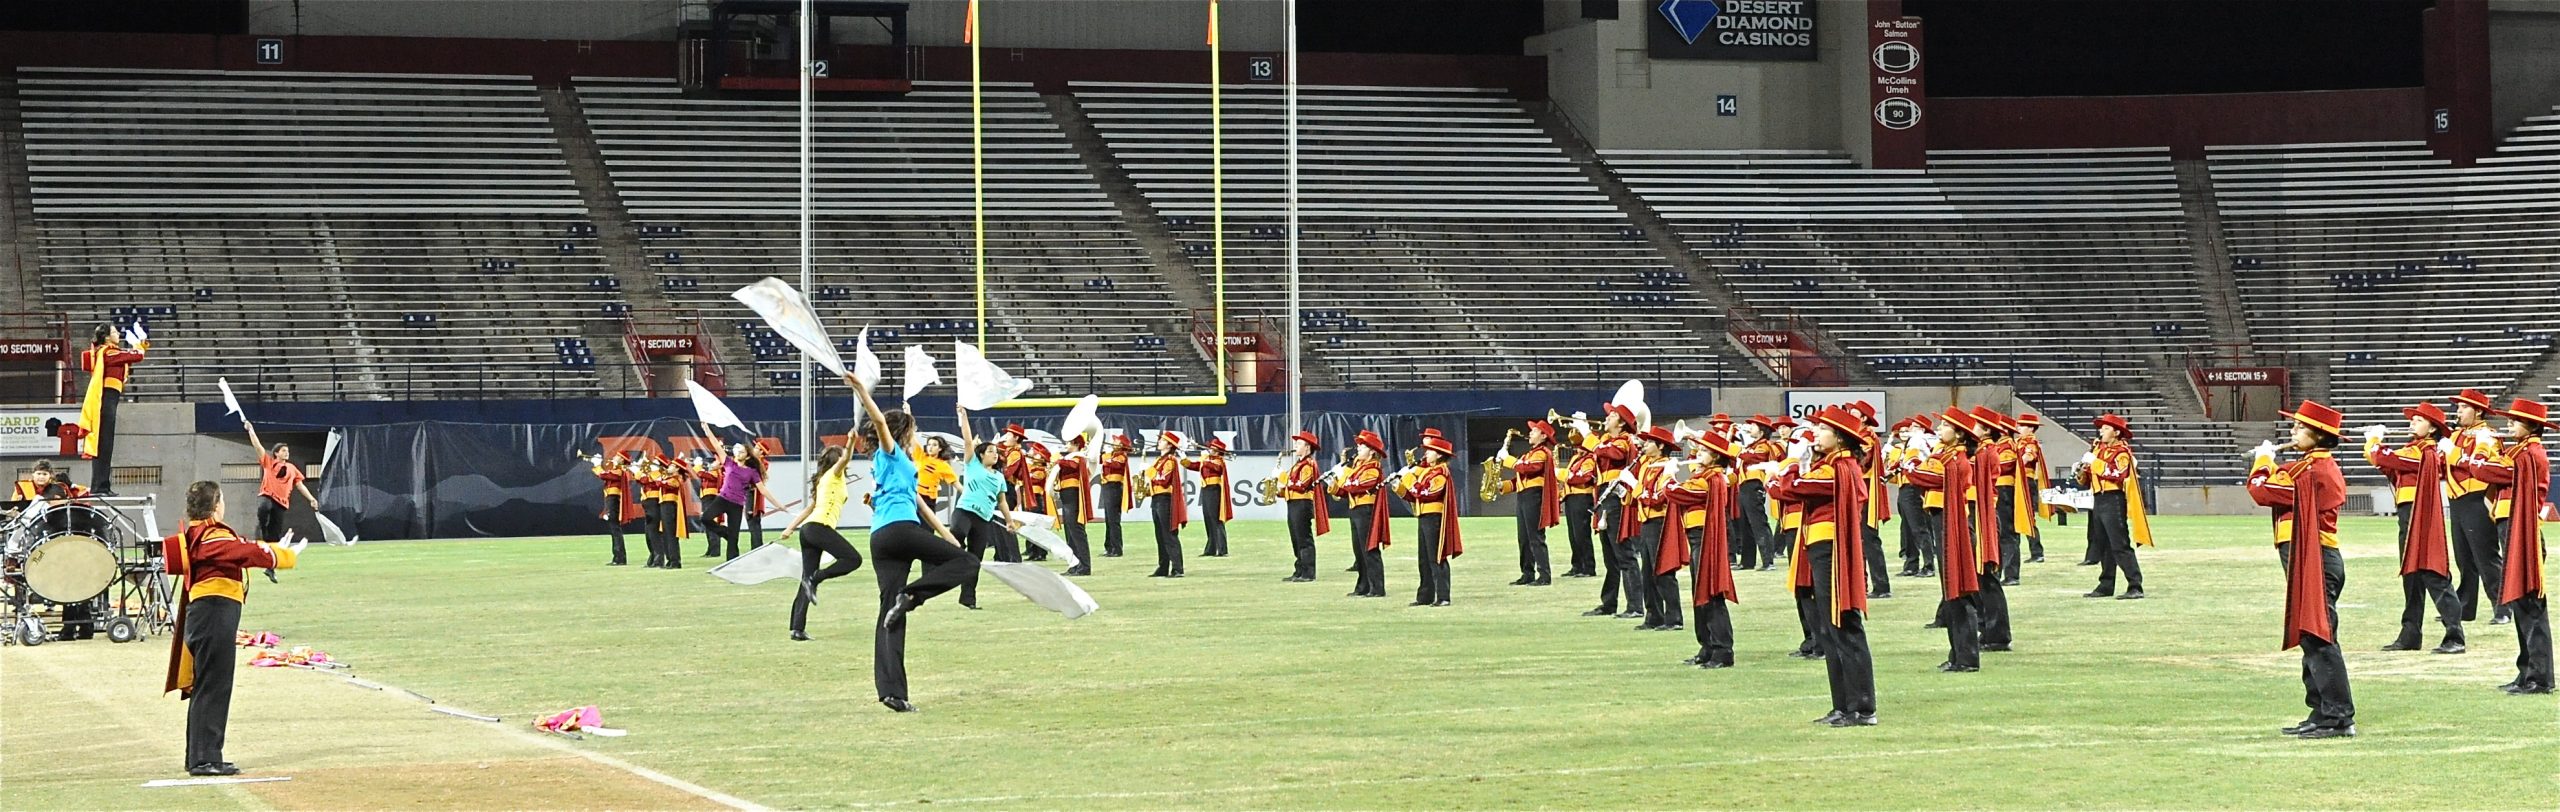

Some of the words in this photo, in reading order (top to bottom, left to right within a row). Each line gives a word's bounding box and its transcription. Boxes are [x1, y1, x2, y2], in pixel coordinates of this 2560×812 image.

[1726, 0, 1803, 14] DESERT
[1716, 16, 1813, 30] DIAMOND
[1875, 20, 1890, 28] John
[1884, 29, 1908, 37] Salmon
[1719, 32, 1810, 46] CASINOS
[261, 43, 279, 60] 11
[808, 61, 827, 77] 12
[1251, 61, 1271, 77] 13
[1877, 76, 1917, 85] McCollins
[1885, 86, 1909, 94] Umeh
[1717, 98, 1736, 114] 14
[1892, 110, 1904, 118] 90
[2435, 113, 2448, 129] 15
[647, 339, 677, 349] SECTION
[678, 339, 686, 349] 12
[1215, 336, 1242, 345] SCTION
[1243, 336, 1250, 345] 13
[0, 344, 9, 354] 10
[10, 344, 43, 354] SECTION
[44, 344, 52, 354] 11
[2215, 371, 2222, 380] 14
[2223, 371, 2252, 380] SECTION
[2253, 371, 2261, 380] 15
[24, 416, 40, 426] UP
